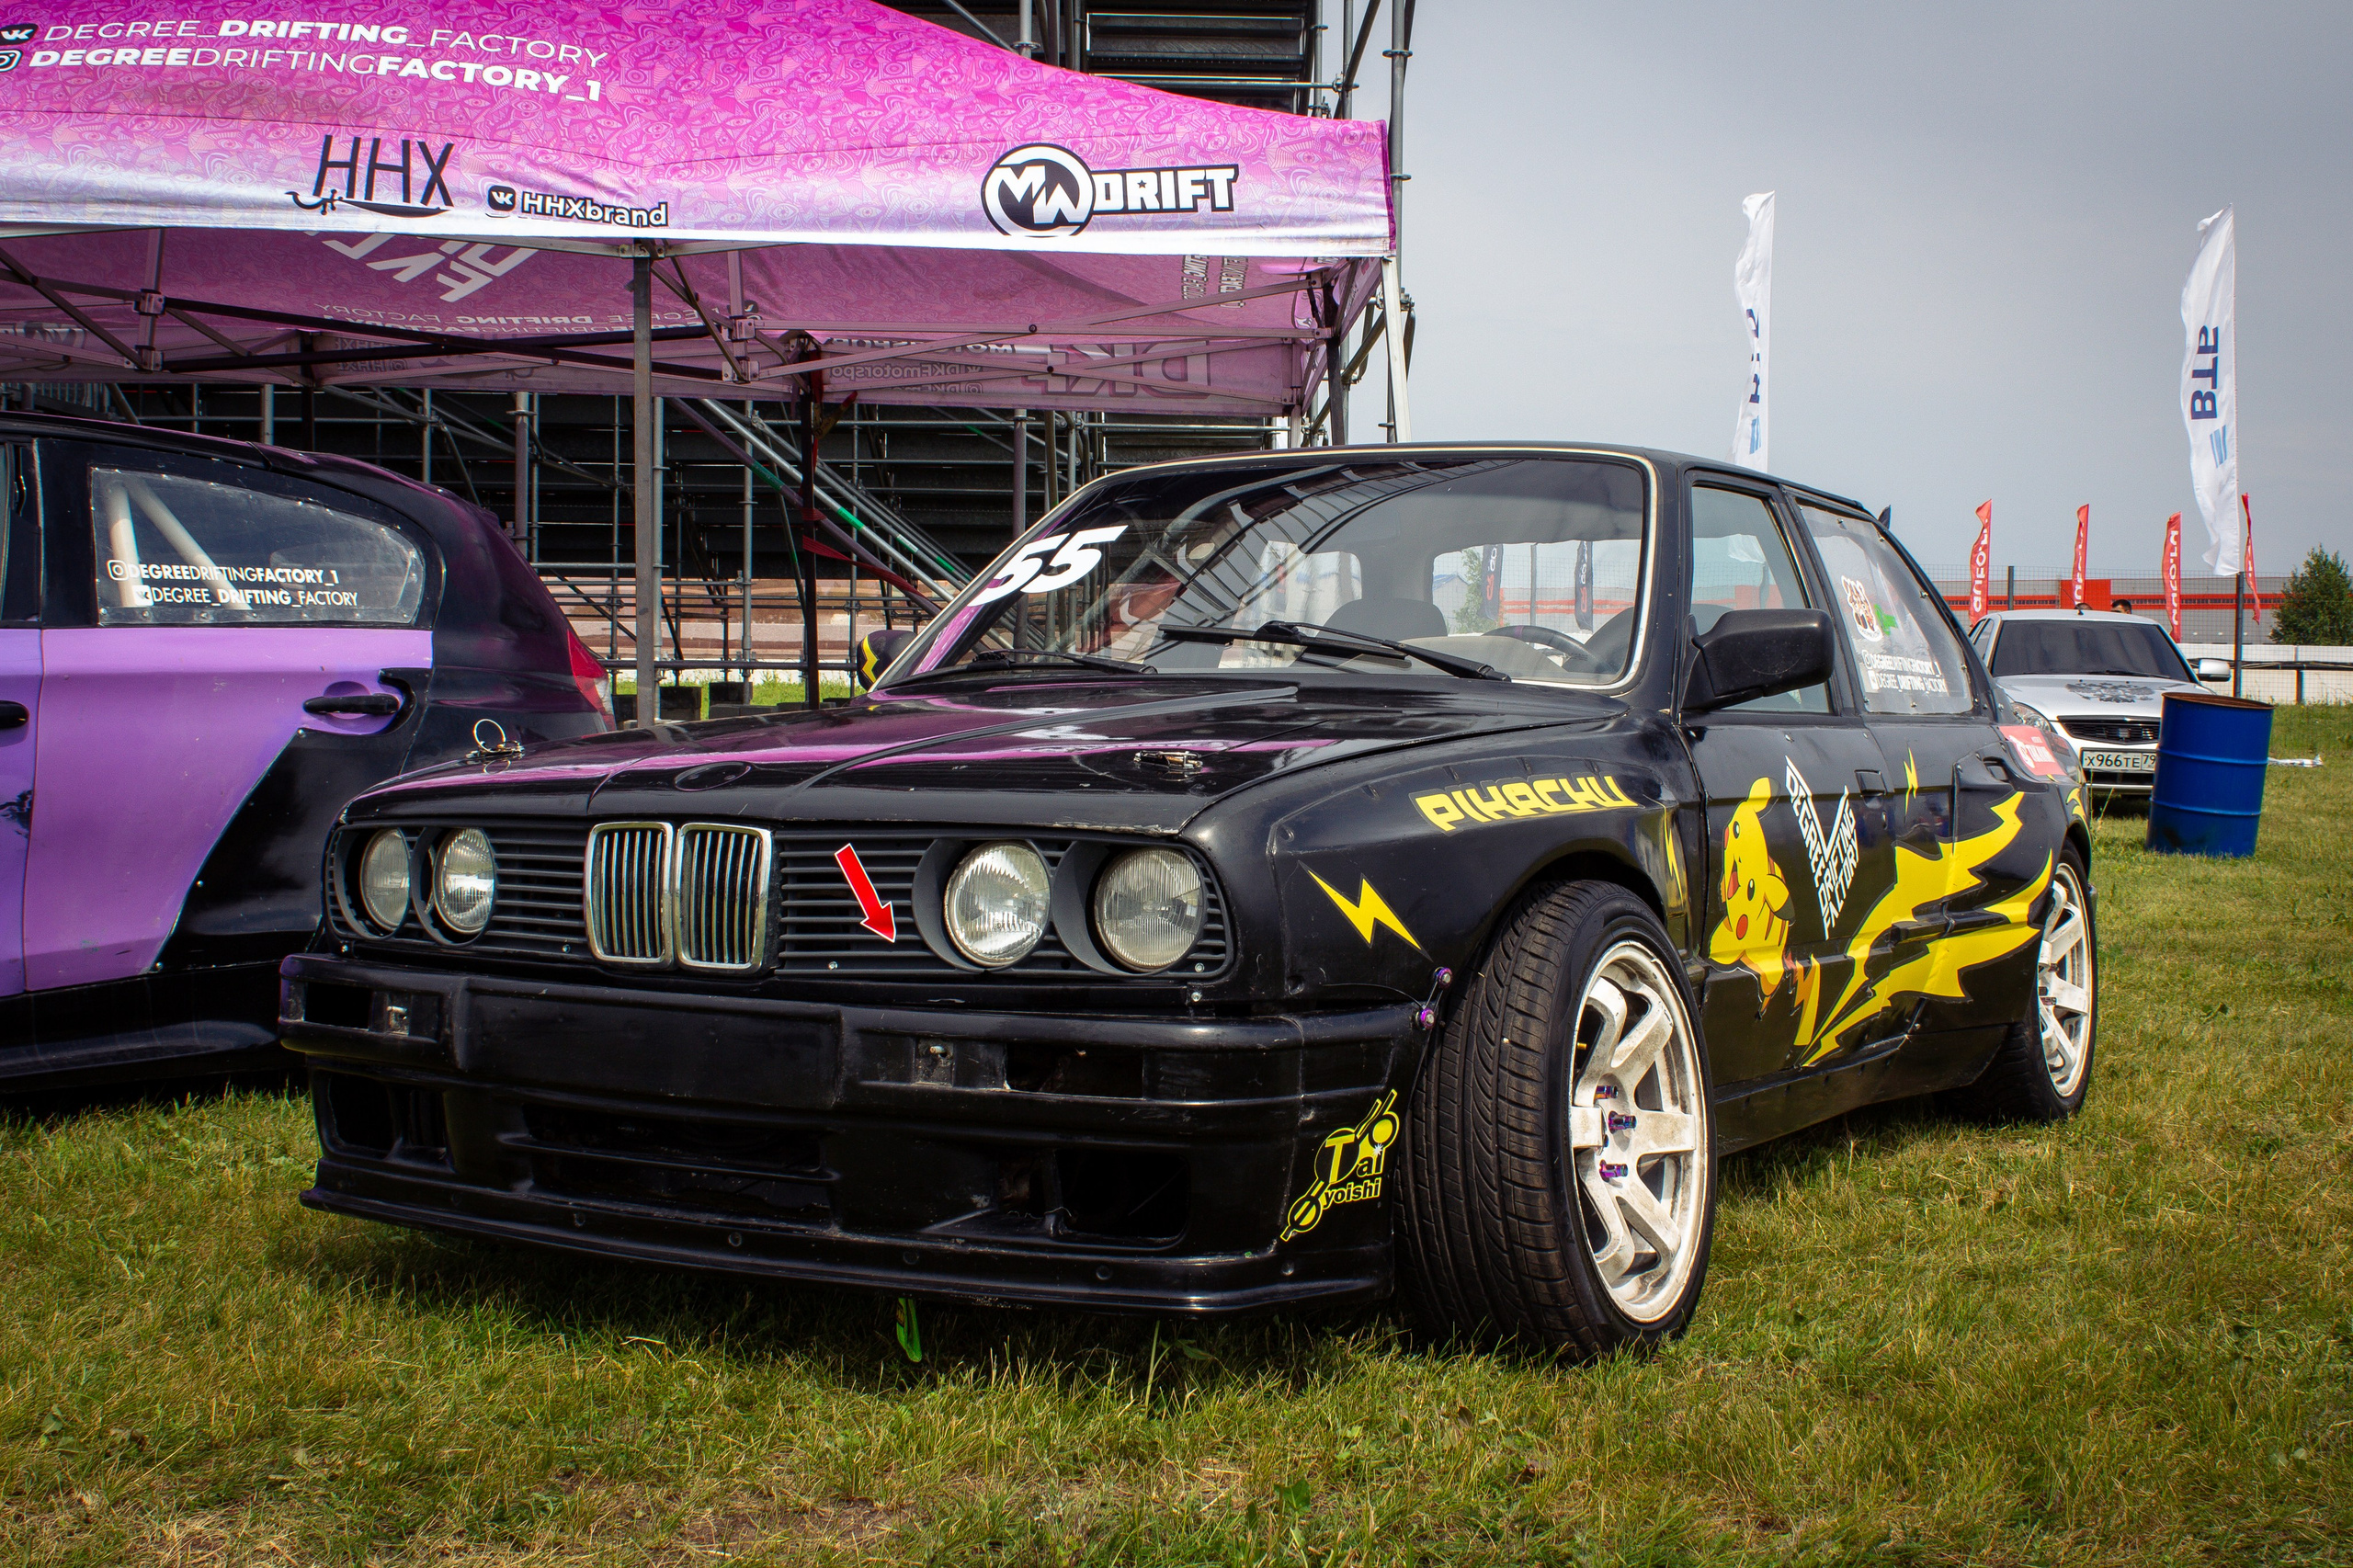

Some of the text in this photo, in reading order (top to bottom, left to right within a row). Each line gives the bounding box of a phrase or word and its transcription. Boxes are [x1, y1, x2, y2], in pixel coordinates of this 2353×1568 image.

[28, 48, 601, 101] DEGREEDRIFTINGFACTORY_1
[521, 191, 668, 228] HHXbrand
[1091, 167, 1235, 212] DRIFT
[128, 563, 339, 586] DEGREEDRIFTINGFACTORY_1
[967, 524, 1129, 607] 55
[1415, 775, 1639, 831] PIKACHU
